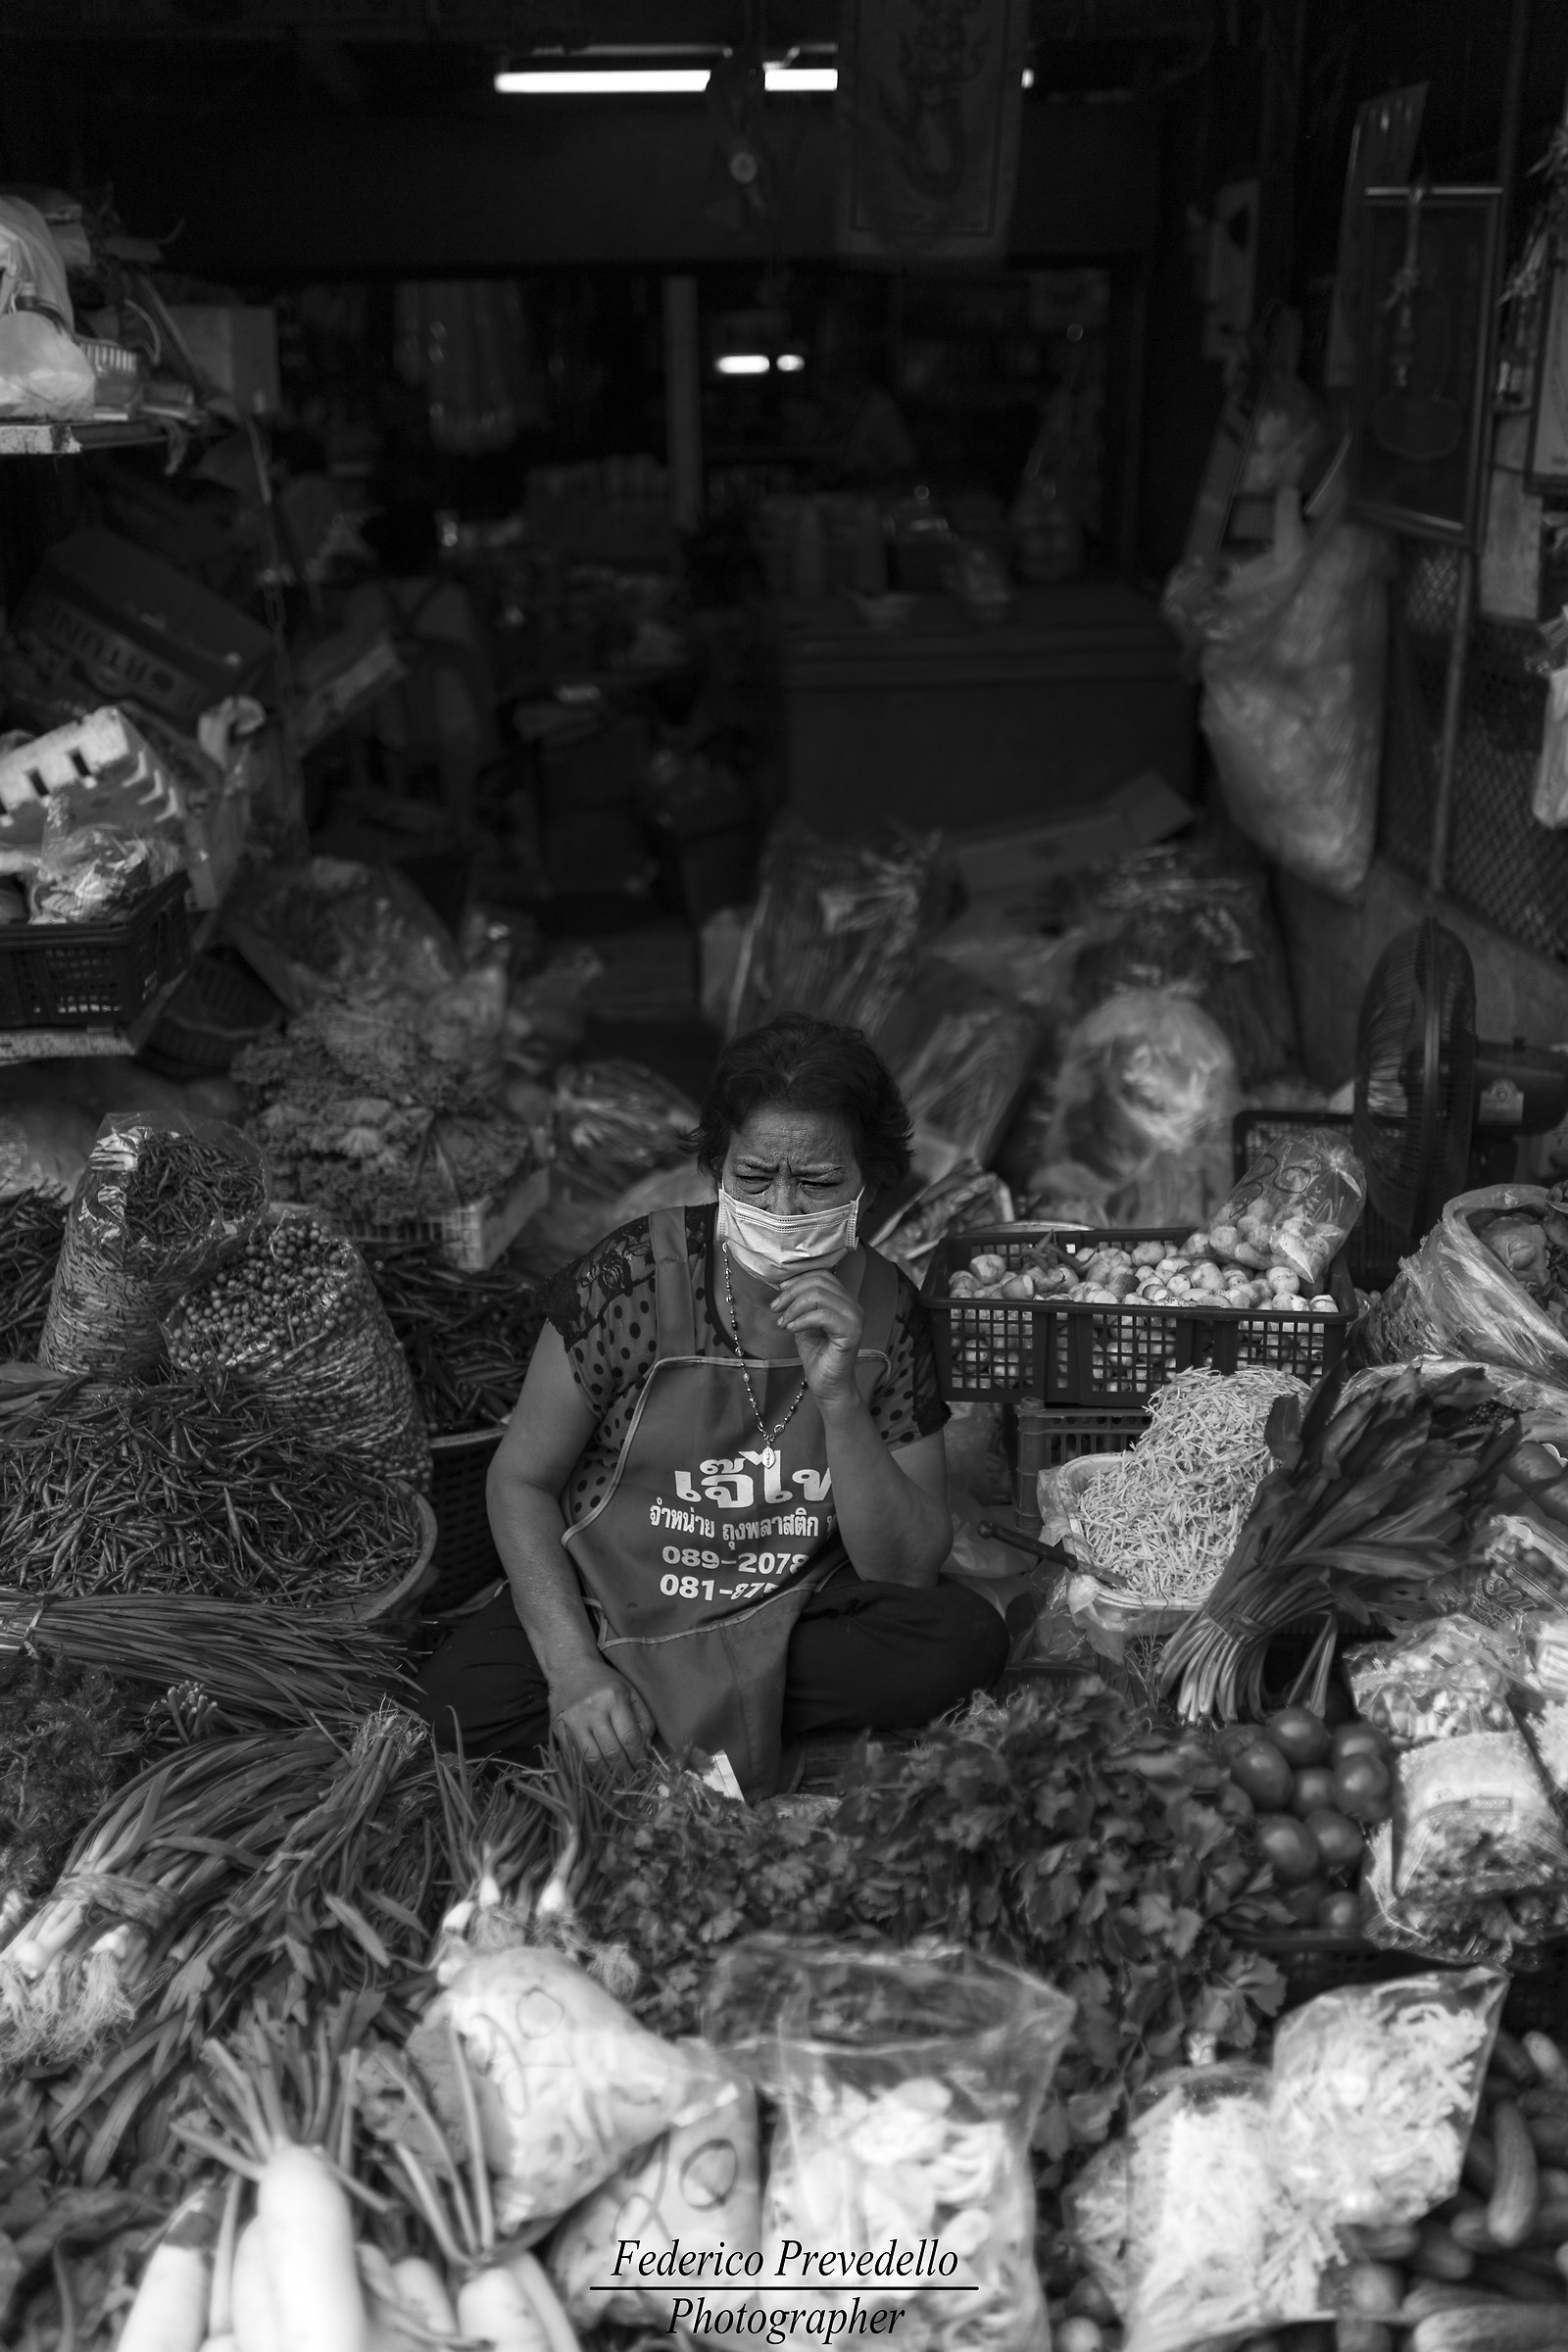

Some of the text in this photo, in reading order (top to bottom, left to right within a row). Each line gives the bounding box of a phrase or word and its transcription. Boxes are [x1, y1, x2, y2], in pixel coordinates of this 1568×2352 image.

[649, 1496, 715, 1540] จำหน่าย
[722, 1507, 819, 1551] ถุงพลาสติก
